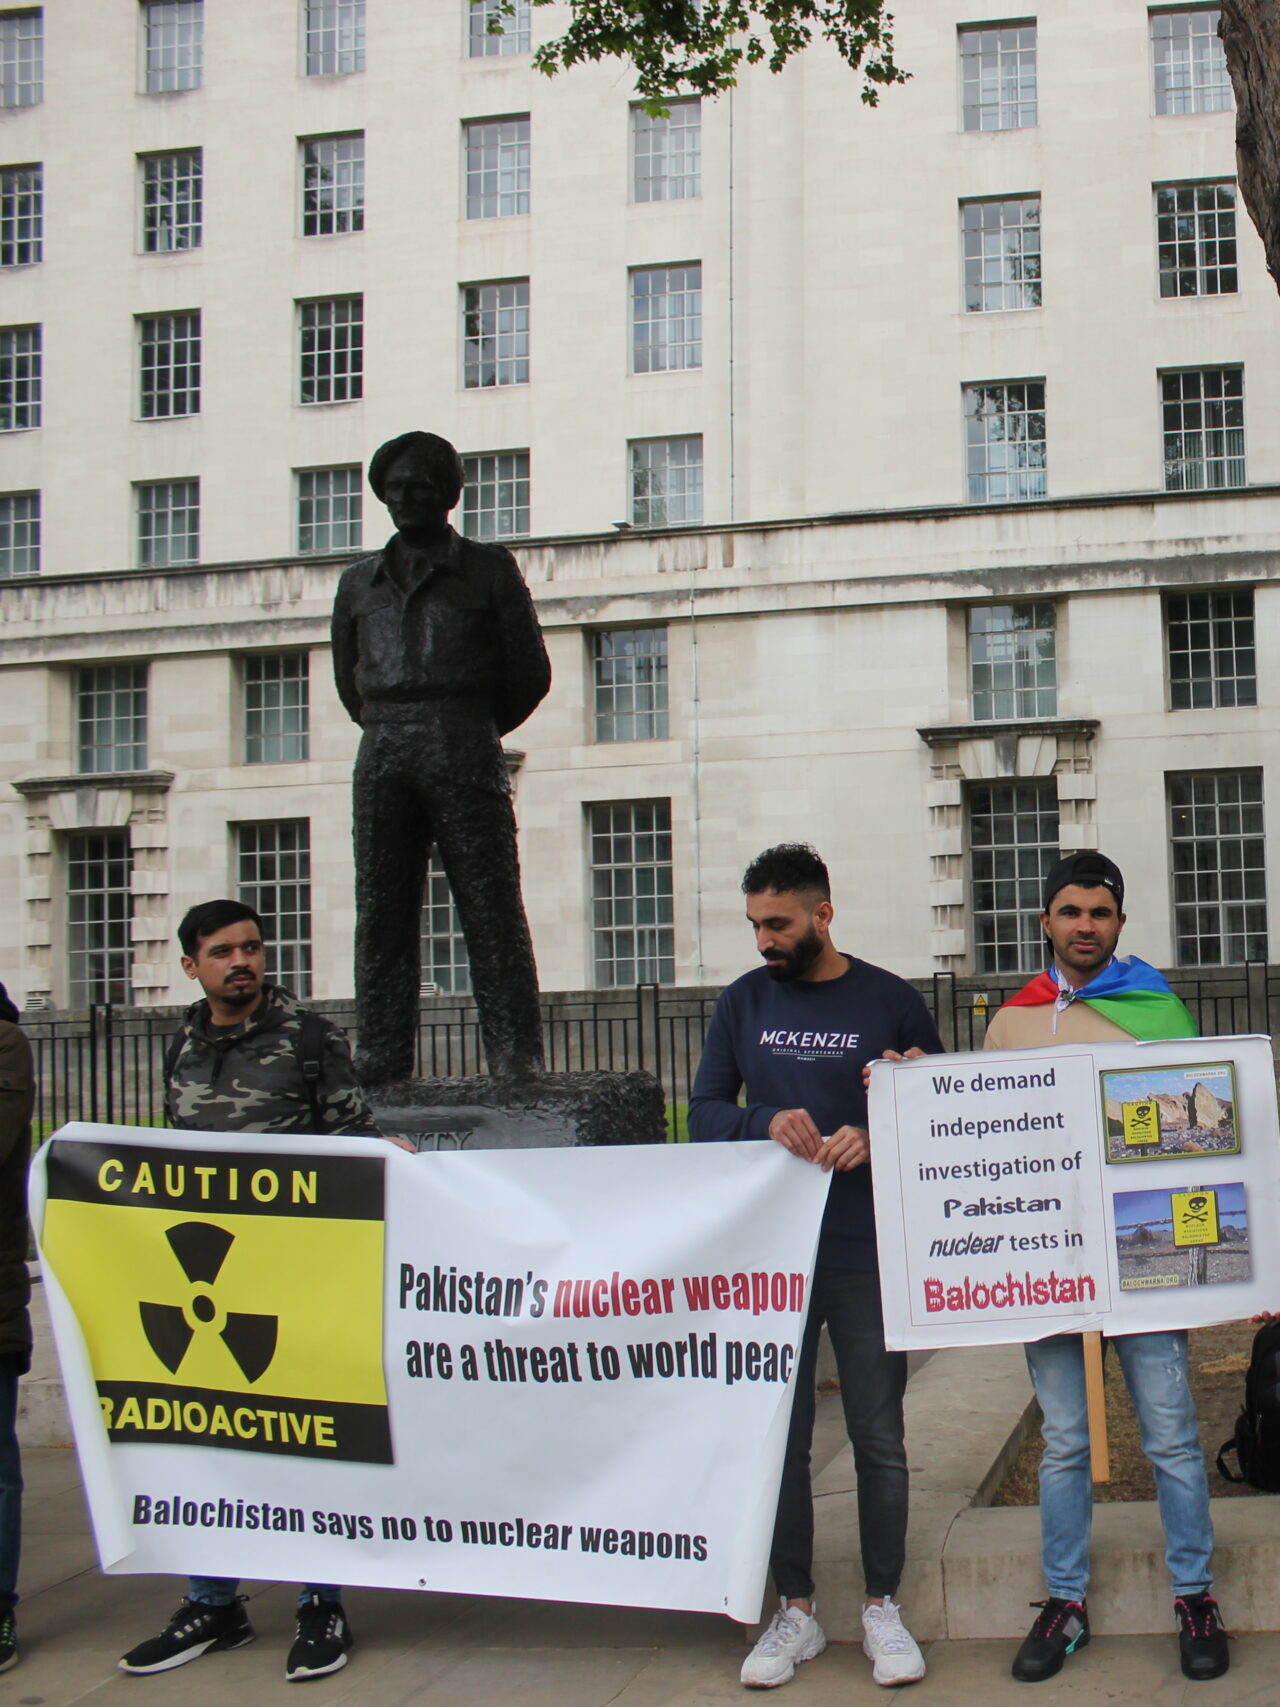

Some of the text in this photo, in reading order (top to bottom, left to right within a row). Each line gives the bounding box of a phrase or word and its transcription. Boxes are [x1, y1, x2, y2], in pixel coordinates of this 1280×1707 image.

[760, 1030, 860, 1048] MCKENZIE
[932, 1067, 1056, 1095] We demand
[930, 1112, 1065, 1139] independent
[97, 1158, 318, 1204] CAUTION
[918, 1151, 1082, 1181] investigation of
[943, 1196, 1062, 1218] Pakistan
[929, 1229, 1084, 1257] nuclear tests in
[400, 1263, 808, 1319] Pakistan's nuclear weapon
[406, 1332, 797, 1385] are a threat to world peac
[98, 1396, 337, 1448] RADIOACTIVE
[132, 1494, 708, 1562] Balochistan says no to nuclear weapons
